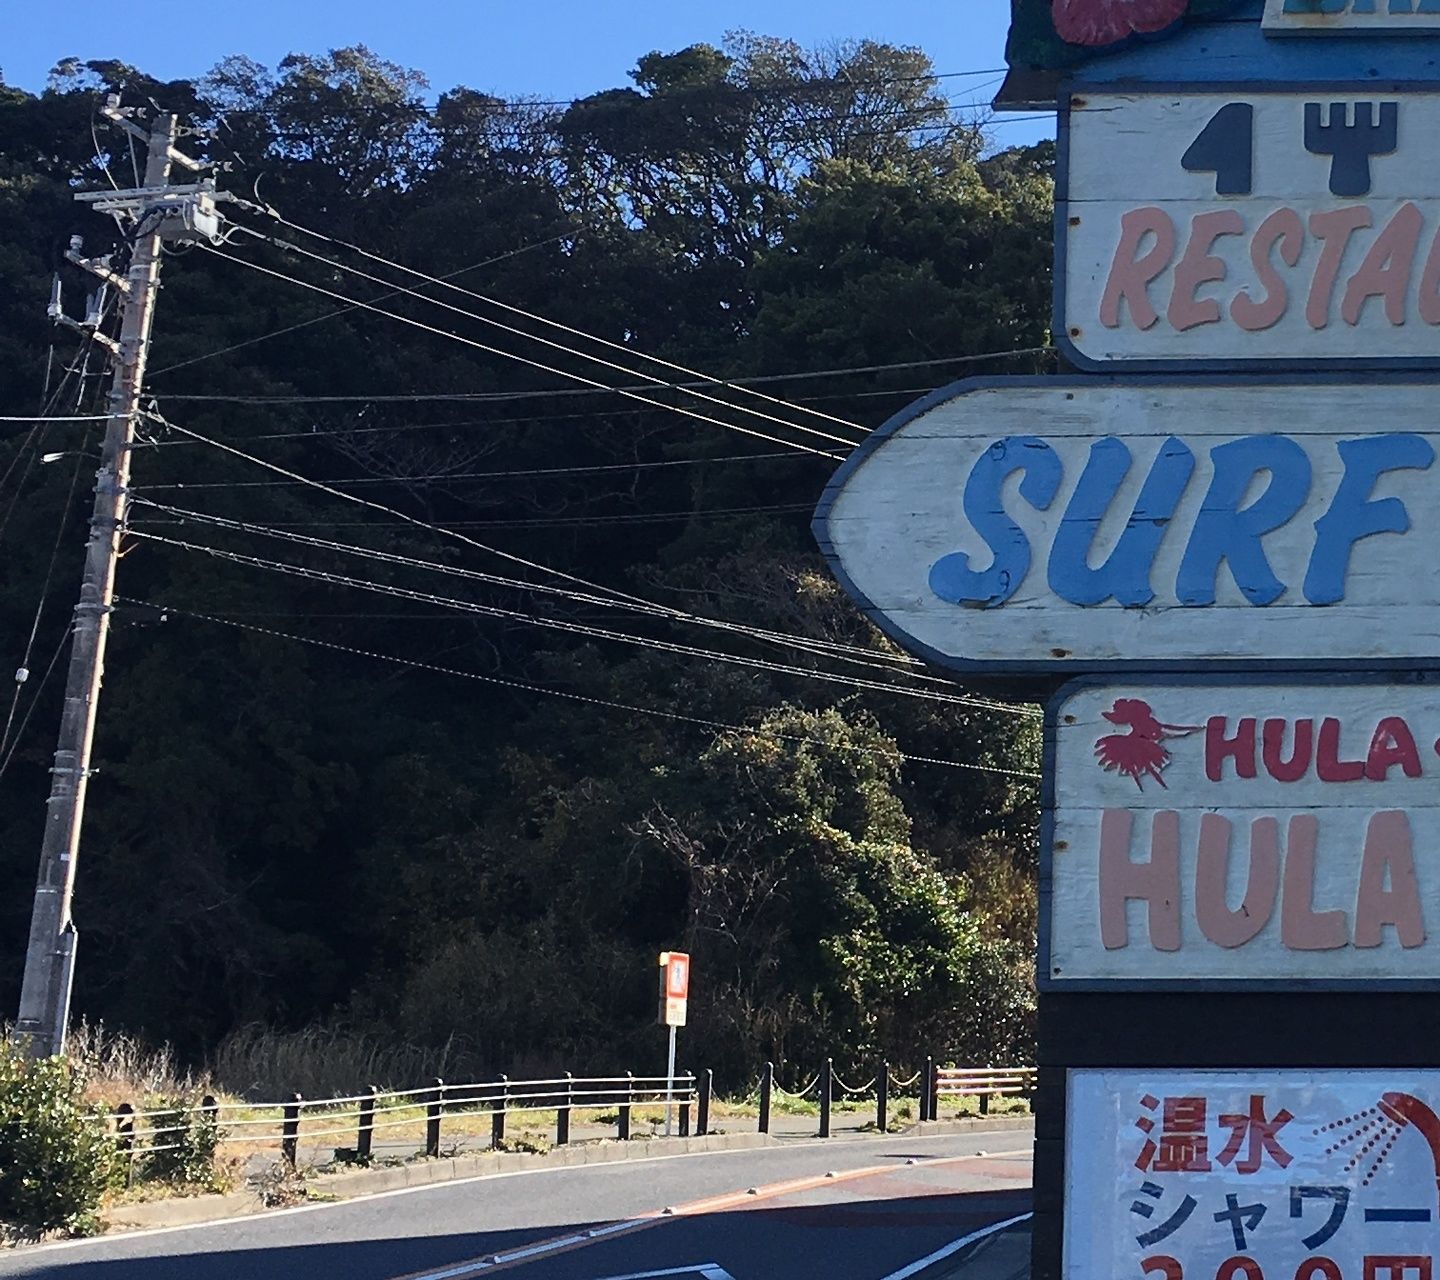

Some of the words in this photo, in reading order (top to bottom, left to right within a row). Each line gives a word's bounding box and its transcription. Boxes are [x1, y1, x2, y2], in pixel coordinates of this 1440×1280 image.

[928, 434, 1434, 607] SURF
[1204, 716, 1423, 782] HULA
[1099, 809, 1427, 952] HULA
[1134, 1094, 1295, 1173] 温水
[1130, 1180, 1431, 1250] シャワー
